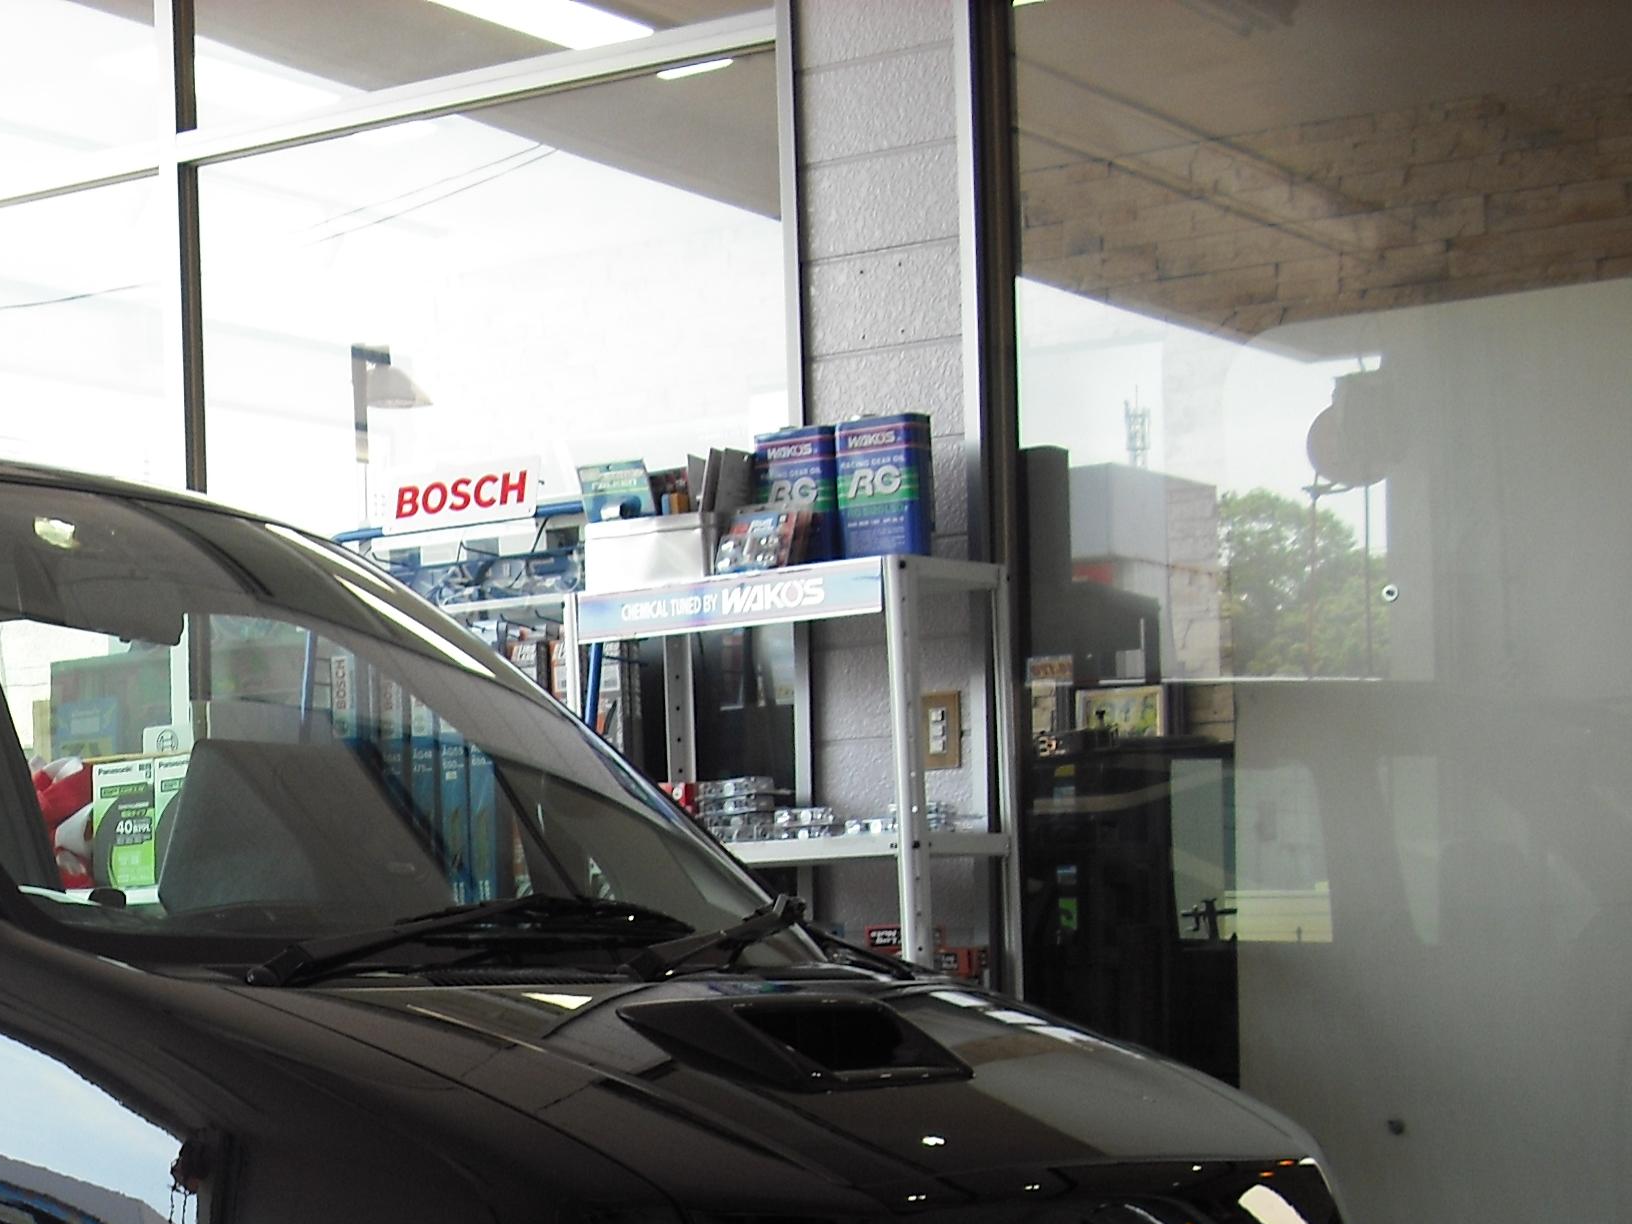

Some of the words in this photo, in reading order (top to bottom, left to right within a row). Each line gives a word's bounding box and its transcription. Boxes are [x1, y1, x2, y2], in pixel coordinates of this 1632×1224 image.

[396, 470, 527, 519] BOSCH
[621, 599, 668, 622] CHEMICAL
[670, 596, 702, 617] TUNED
[703, 593, 718, 614] BY
[335, 659, 346, 710] BOSCH
